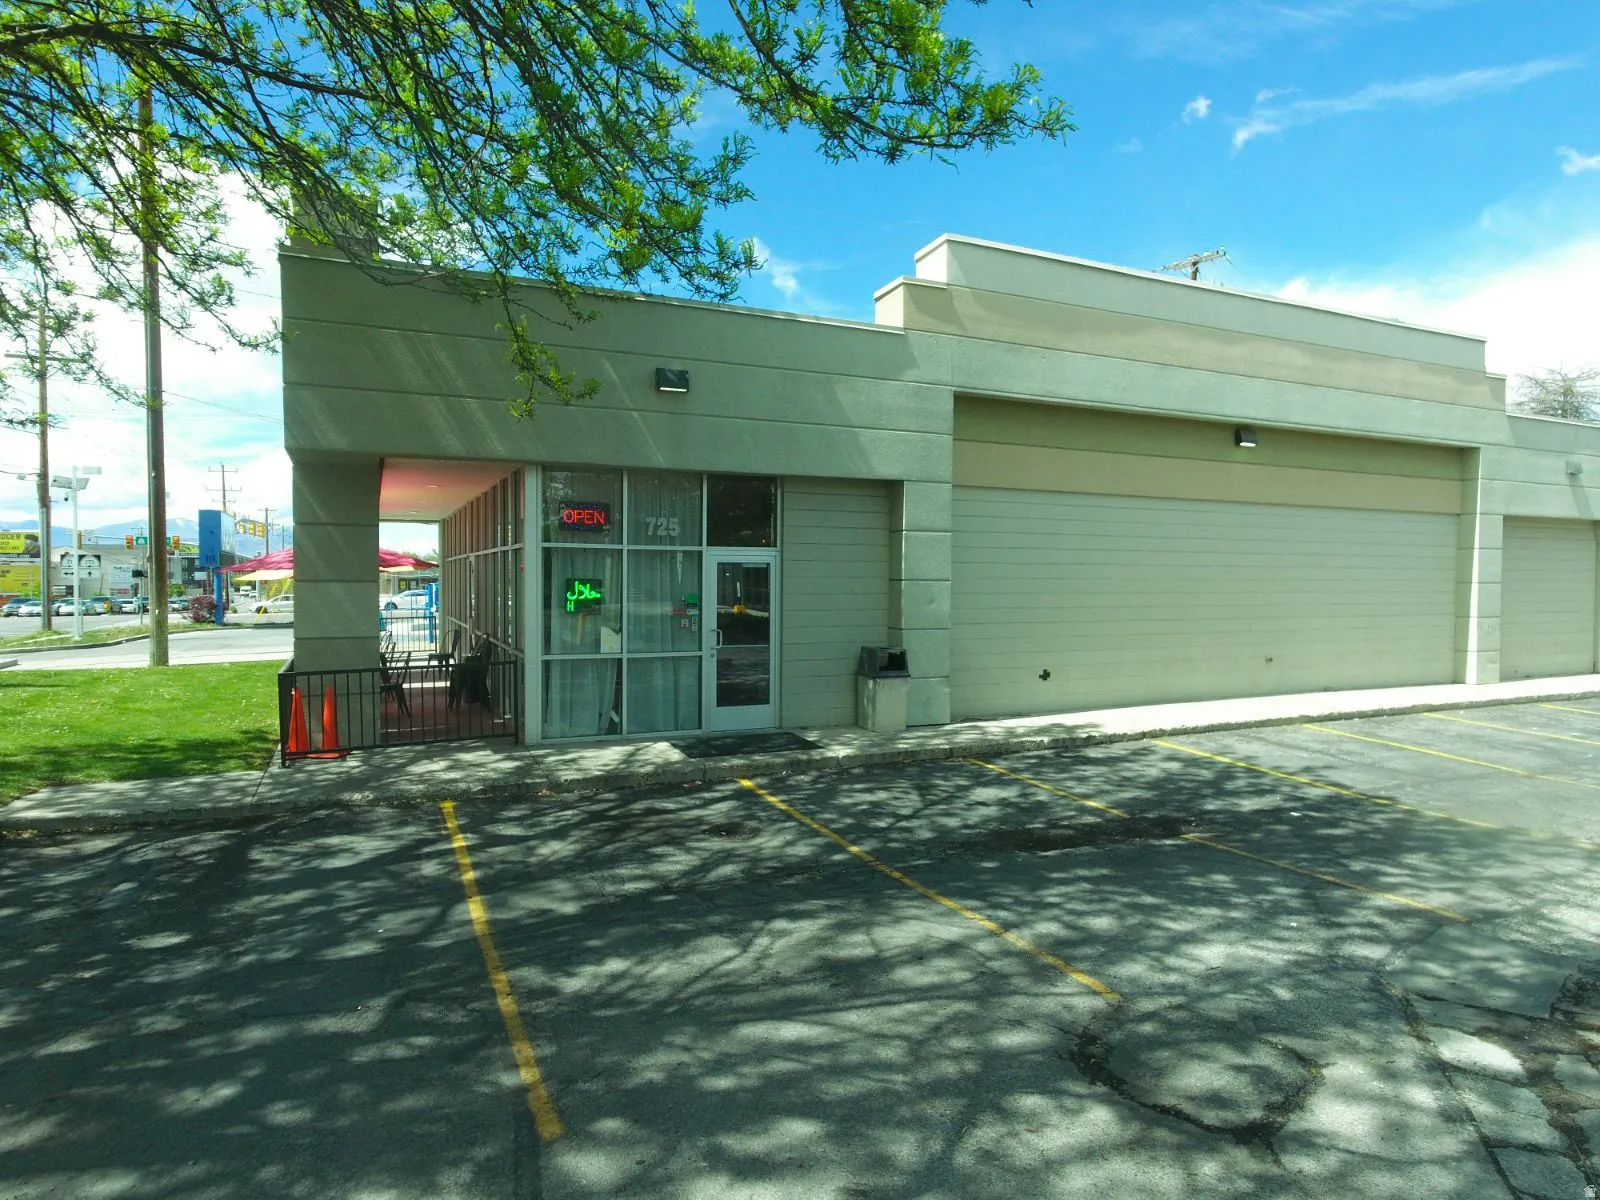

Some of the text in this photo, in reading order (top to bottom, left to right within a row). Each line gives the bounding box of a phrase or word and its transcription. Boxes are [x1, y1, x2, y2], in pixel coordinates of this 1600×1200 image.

[563, 509, 605, 525] OPEN
[646, 517, 680, 537] 725
[567, 581, 602, 600] حلال
